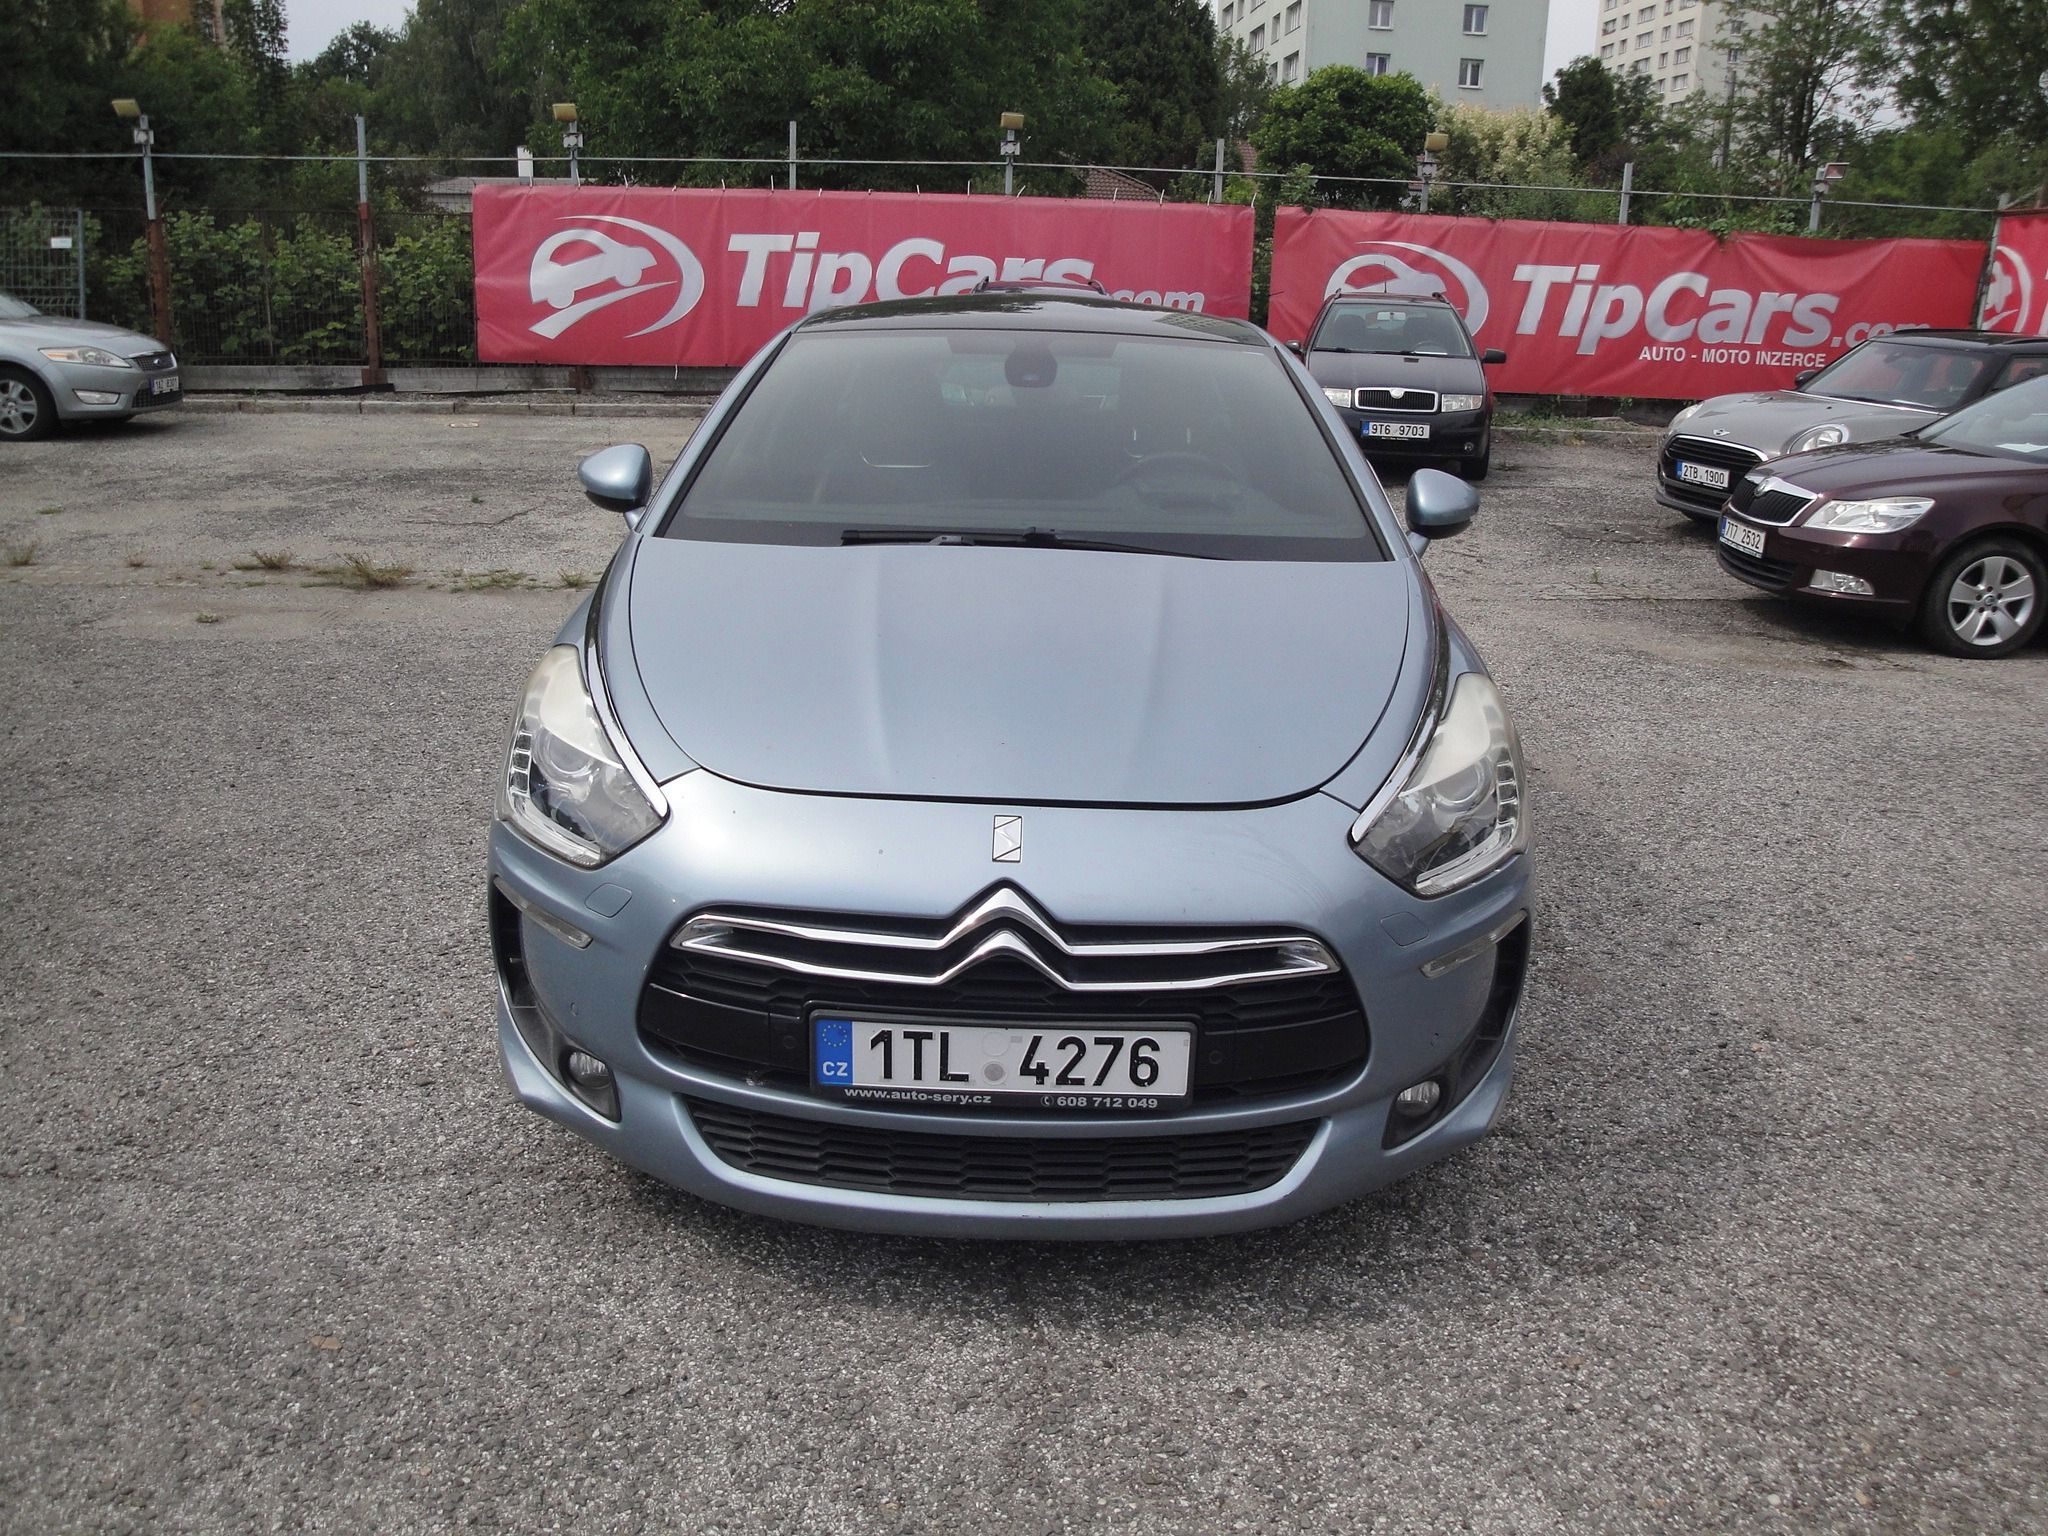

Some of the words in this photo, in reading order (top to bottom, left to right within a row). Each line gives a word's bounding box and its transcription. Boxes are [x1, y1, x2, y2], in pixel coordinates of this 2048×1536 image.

[727, 232, 1204, 312] TipCarsm
[1512, 264, 1930, 355] TipCars.co
[1638, 346, 1686, 362] AUTO
[1702, 348, 1750, 364] MOTO
[1755, 351, 1826, 368] INZERCE
[1371, 423, 1391, 435] 9T6
[1398, 425, 1425, 437] 9703
[1683, 464, 1698, 479] 2TB
[1704, 469, 1725, 485] 1900
[1725, 521, 1738, 540] 7T7
[1741, 528, 1761, 550] 2532
[870, 1029, 970, 1082] 1TL
[1019, 1035, 1161, 1087] 4276
[822, 1061, 848, 1077] CZ
[844, 1087, 992, 1105] www.auto-sery.cz
[1056, 1096, 1088, 1107] 608
[1092, 1096, 1122, 1108] 712
[1127, 1097, 1158, 1109] 049
